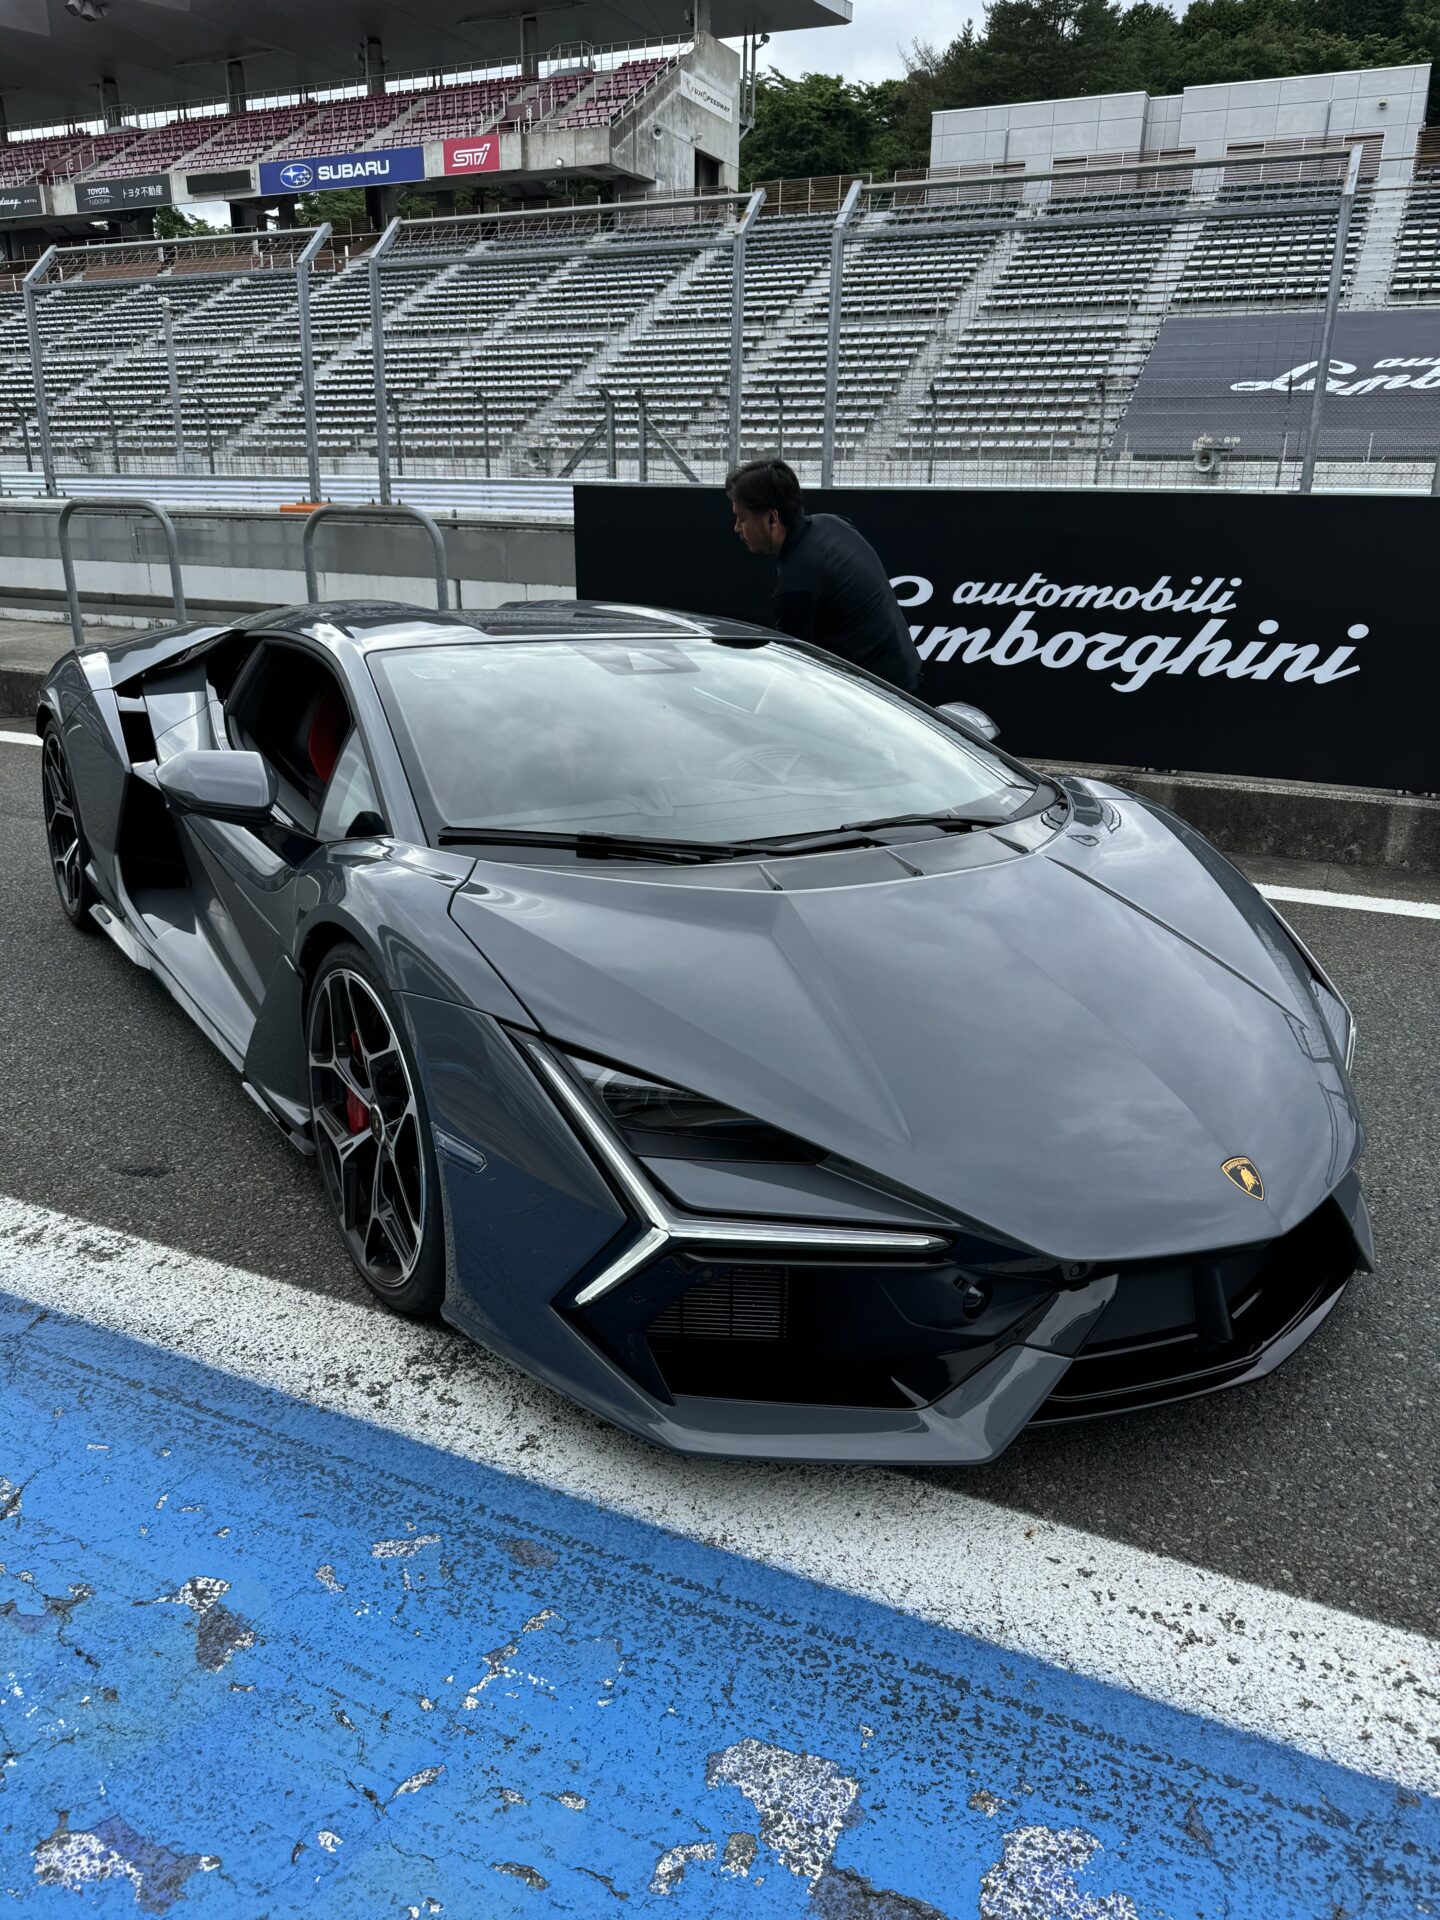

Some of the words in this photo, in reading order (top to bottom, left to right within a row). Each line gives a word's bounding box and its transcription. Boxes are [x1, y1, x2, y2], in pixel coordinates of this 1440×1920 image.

[318, 160, 390, 181] SUBARU
[87, 187, 110, 196] TOYOTA
[122, 185, 163, 199] トヨタ不動産
[953, 572, 1243, 613] automobili
